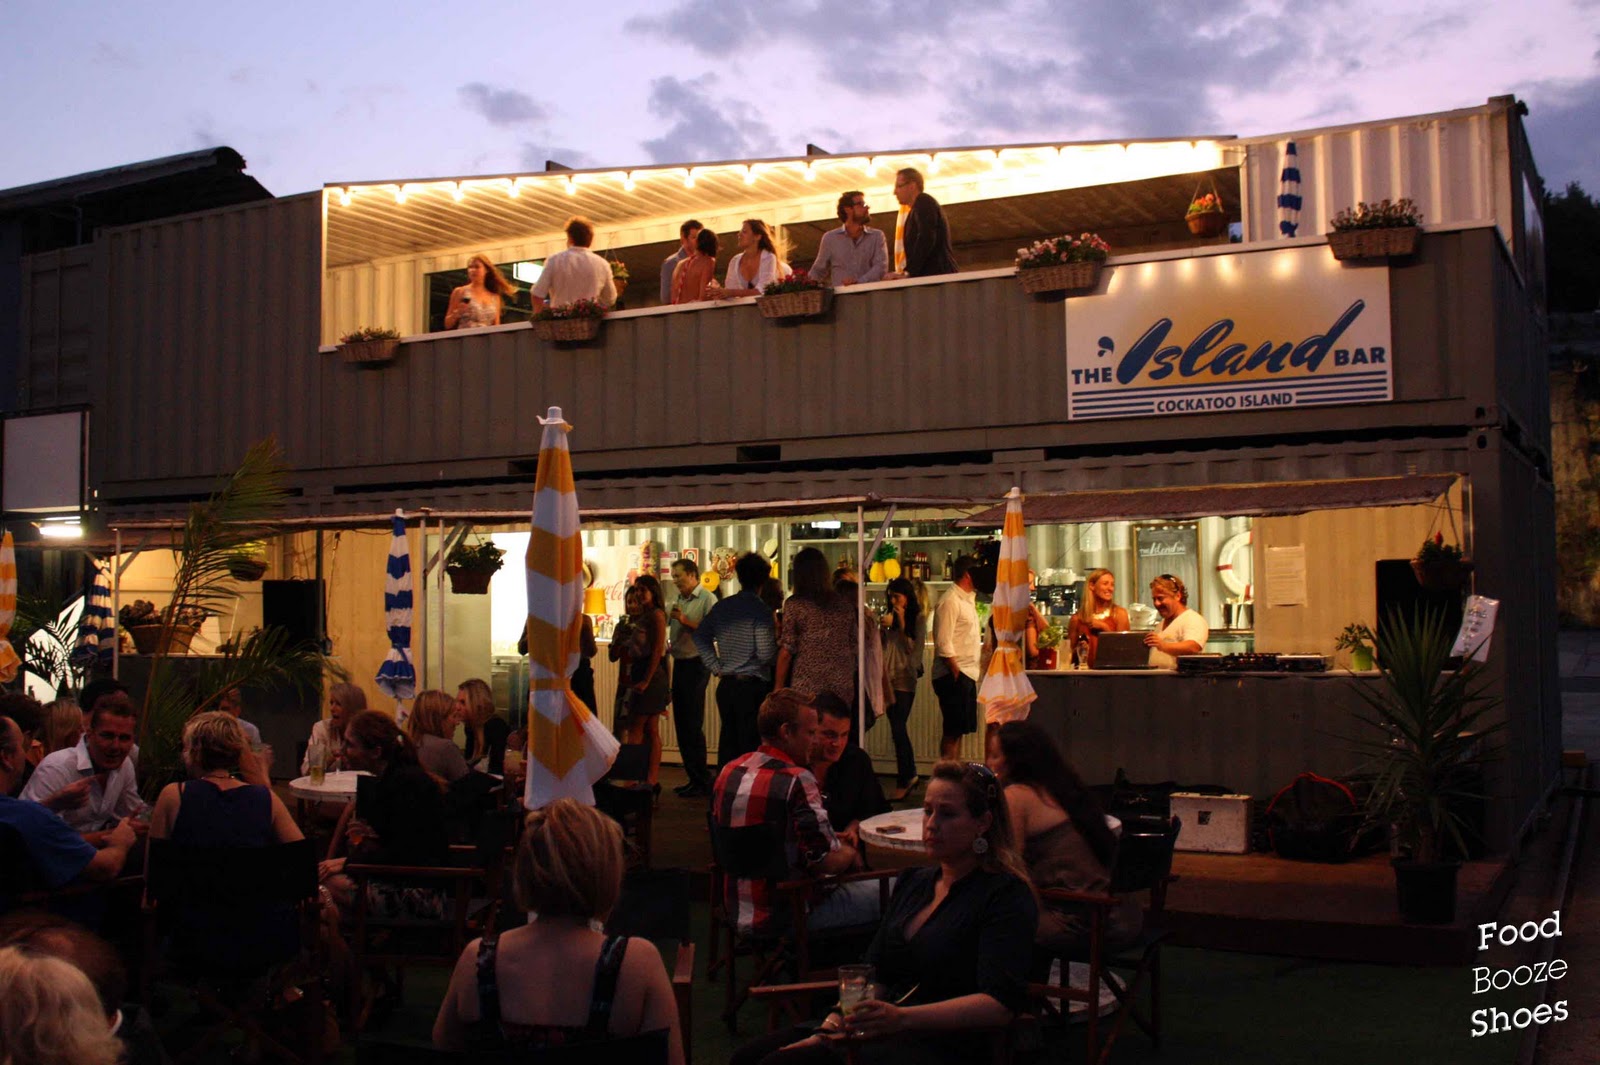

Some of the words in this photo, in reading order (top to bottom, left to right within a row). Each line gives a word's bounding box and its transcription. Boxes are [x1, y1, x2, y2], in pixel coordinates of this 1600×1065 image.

[1071, 367, 1113, 385] THE
[1115, 299, 1366, 385] Island
[1334, 346, 1386, 367] BAR
[1157, 396, 1237, 414] COCKATOO
[1239, 392, 1293, 408] ISLAND
